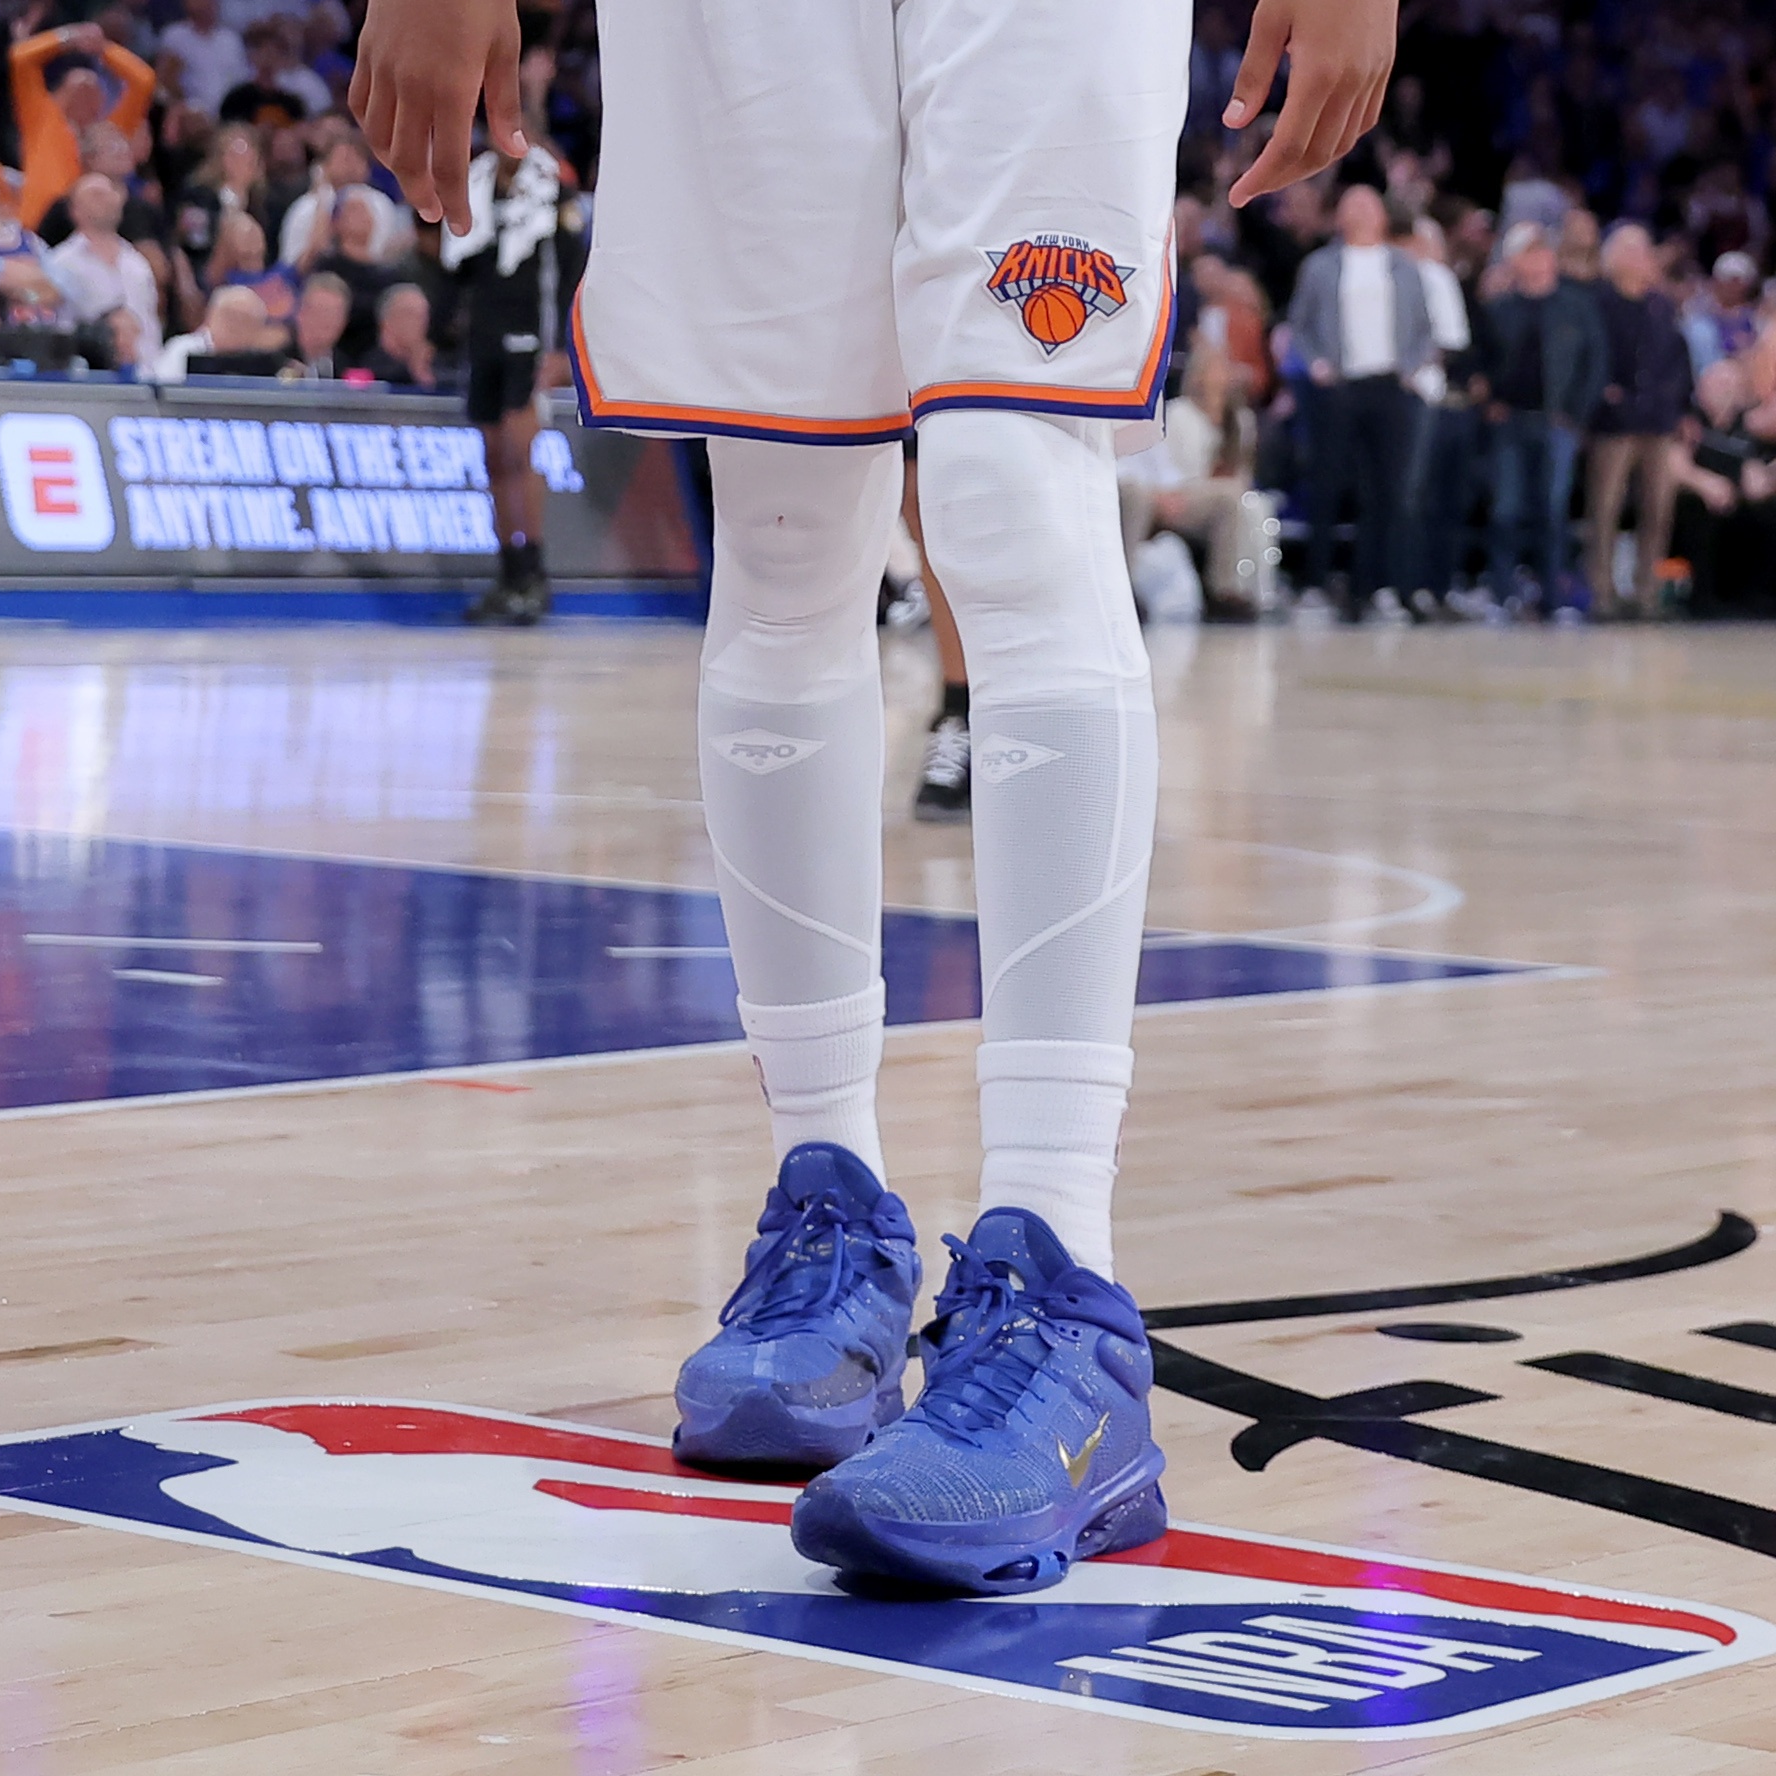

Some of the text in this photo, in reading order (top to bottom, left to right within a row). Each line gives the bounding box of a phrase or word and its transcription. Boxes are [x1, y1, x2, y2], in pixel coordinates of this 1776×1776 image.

[987, 239, 1128, 308] KNICKS
[1034, 234, 1091, 252] NEW YORK
[108, 415, 277, 483] STREAM
[267, 419, 337, 487] ON
[326, 422, 409, 489] THE
[308, 486, 500, 555] ANYWHER
[1053, 1614, 1544, 1712] NBA
